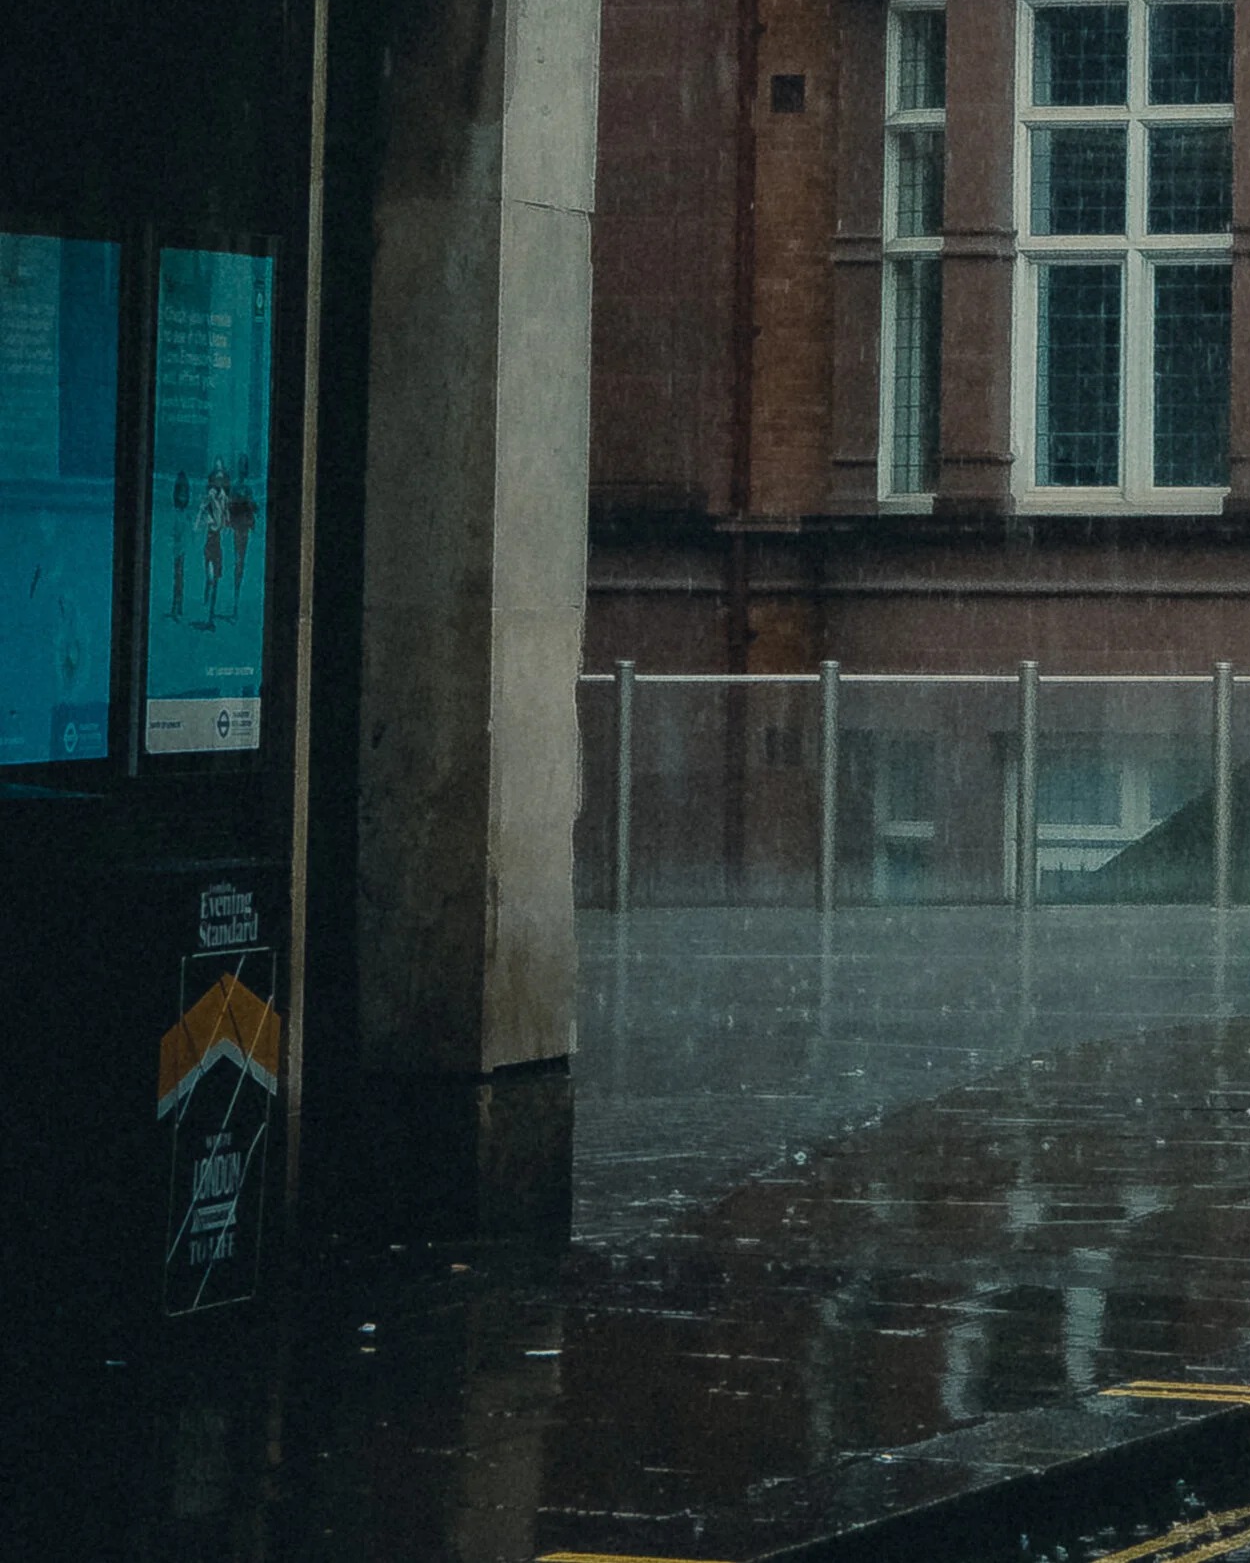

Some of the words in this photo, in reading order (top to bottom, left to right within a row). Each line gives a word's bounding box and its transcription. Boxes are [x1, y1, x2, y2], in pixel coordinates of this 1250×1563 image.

[200, 892, 253, 920] Evening
[199, 913, 258, 947] Standard
[193, 1151, 241, 1200] LONDON
